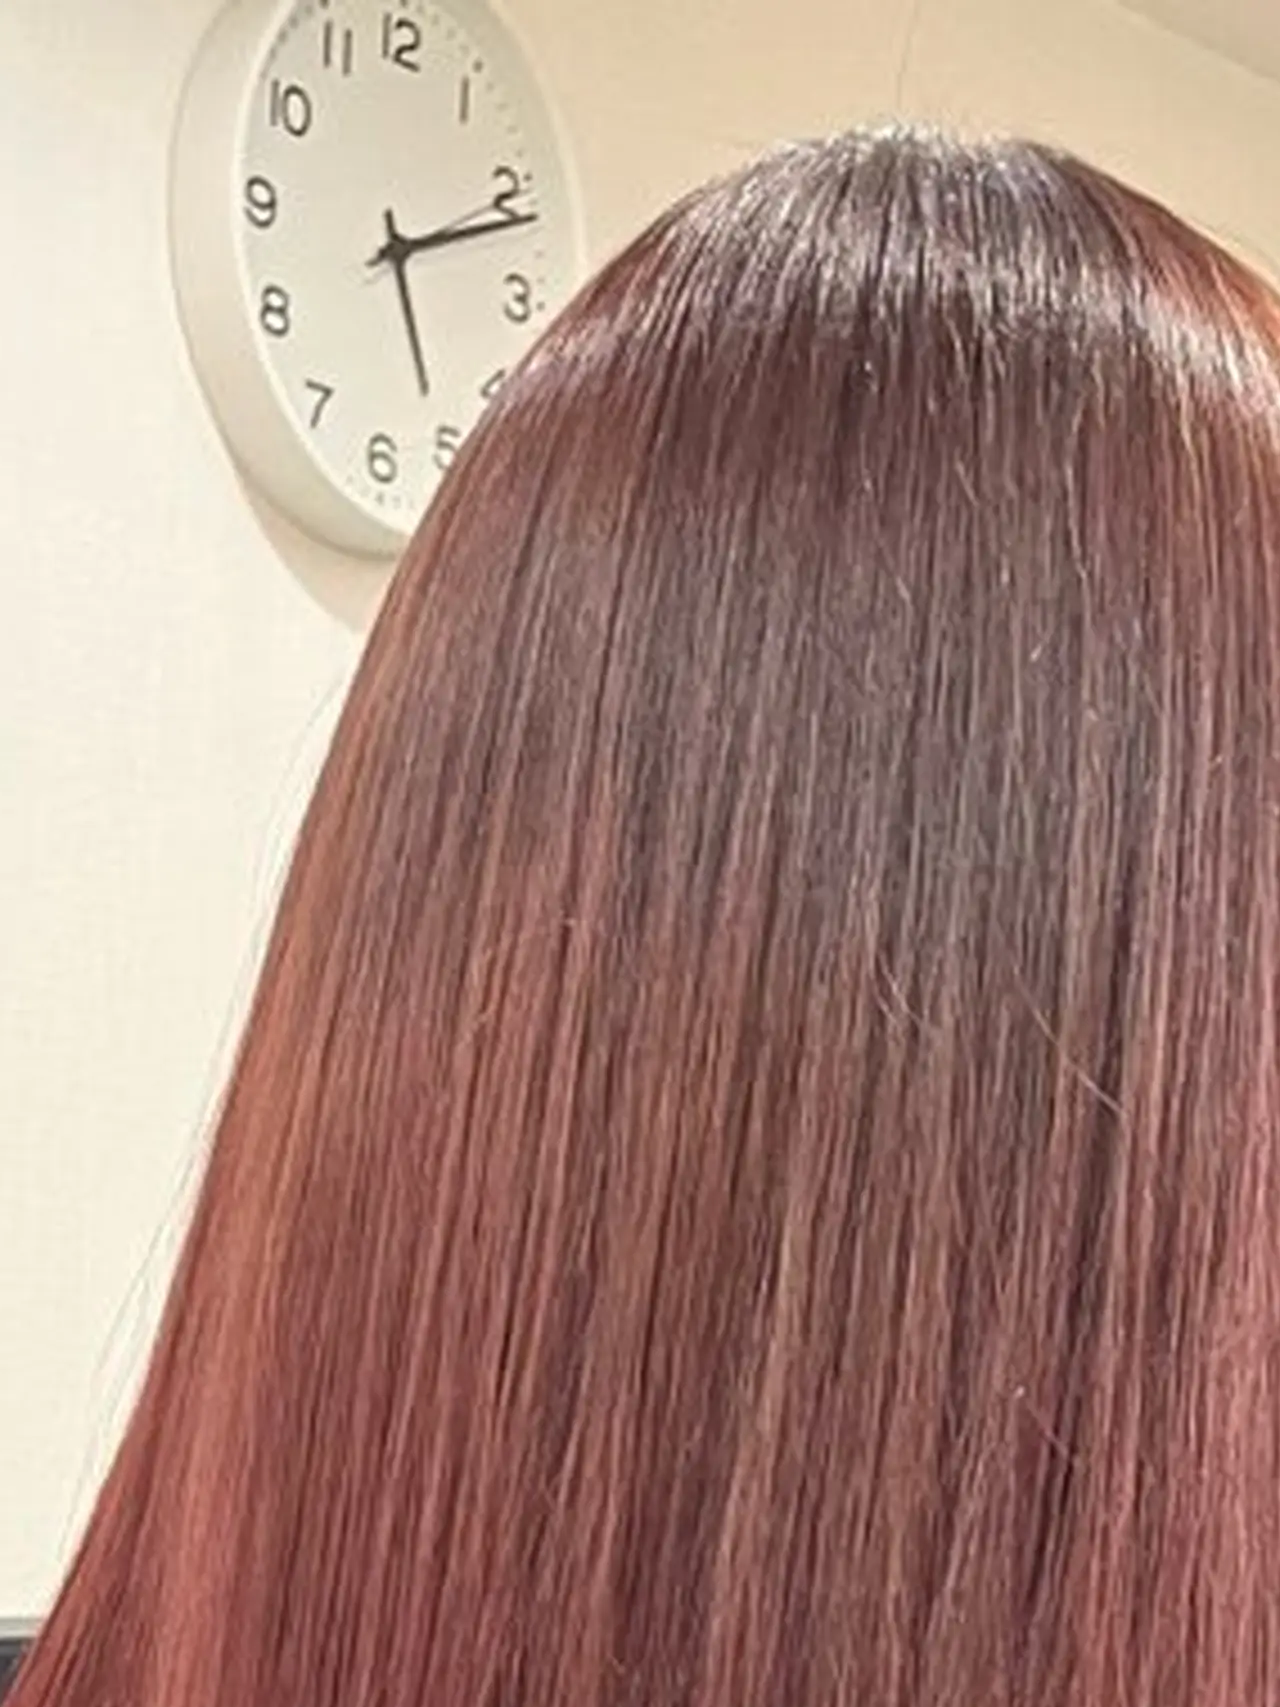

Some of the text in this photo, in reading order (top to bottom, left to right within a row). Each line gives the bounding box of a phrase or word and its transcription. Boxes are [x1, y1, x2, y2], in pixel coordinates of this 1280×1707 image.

[322, 19, 354, 76] 11
[382, 13, 421, 73] 12
[269, 78, 313, 138] 10
[458, 75, 470, 124] 1
[243, 175, 277, 230] 9
[491, 165, 523, 223] 2
[259, 284, 291, 338] 8
[502, 272, 532, 325] 3
[304, 378, 335, 430] 7
[365, 432, 398, 485] 6
